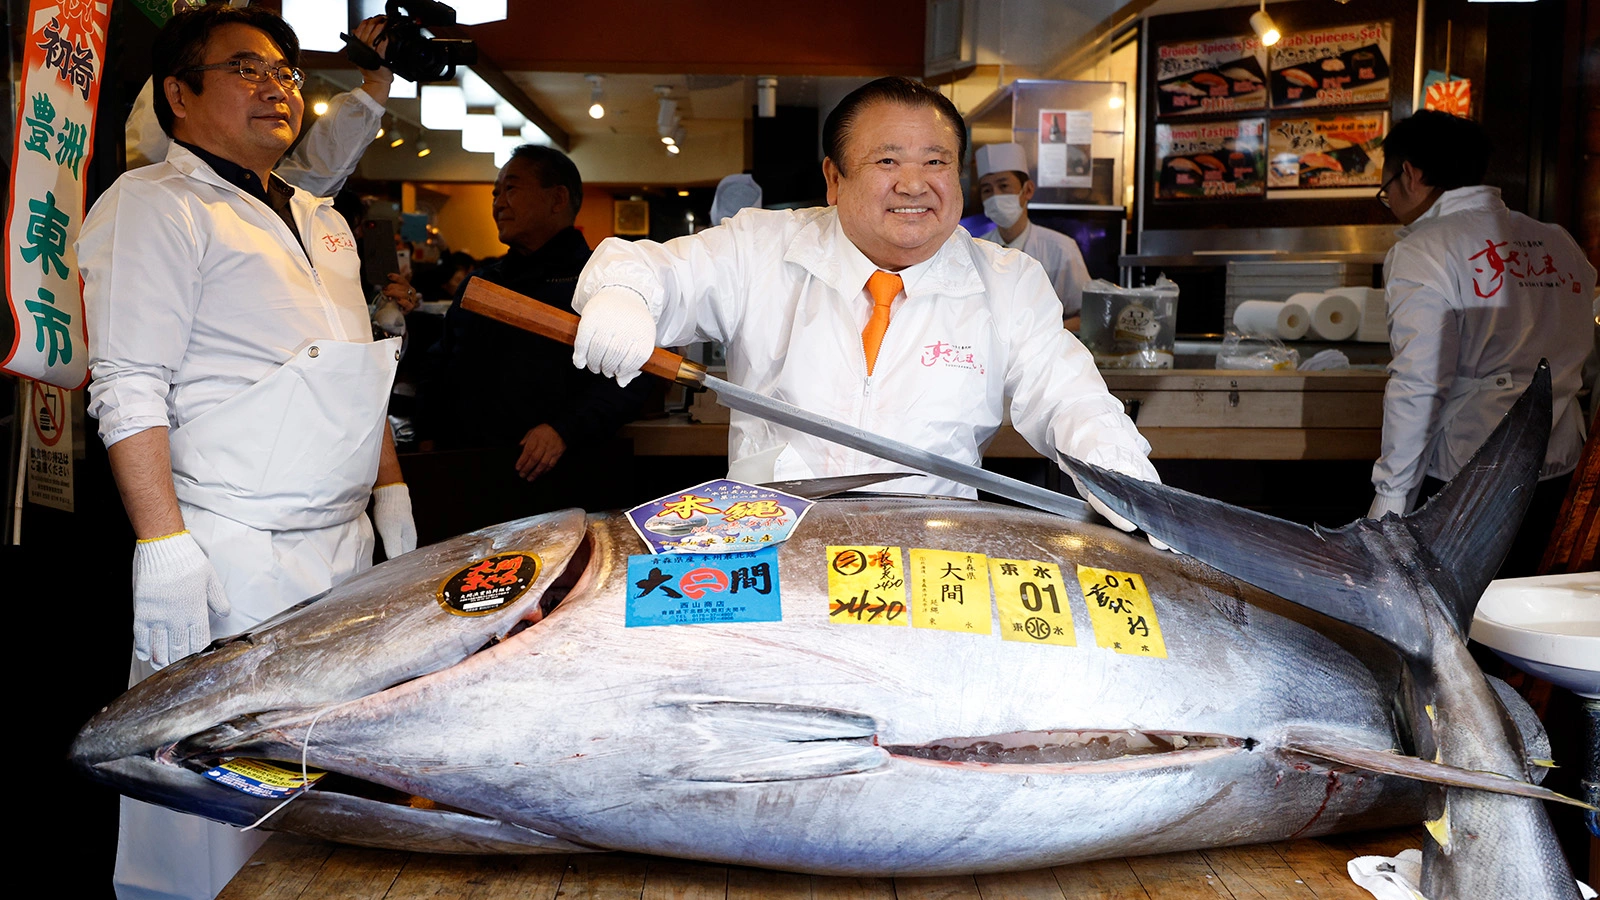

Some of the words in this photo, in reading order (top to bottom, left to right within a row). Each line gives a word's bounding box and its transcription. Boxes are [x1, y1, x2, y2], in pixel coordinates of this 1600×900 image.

[1307, 32, 1356, 45] 3pieces
[1360, 28, 1381, 39] Set
[38, 17, 94, 101] 初荷
[24, 91, 87, 181] 豊洲
[940, 562, 966, 605] 大間
[1019, 582, 1061, 614] 01
[1105, 574, 1137, 590] 01
